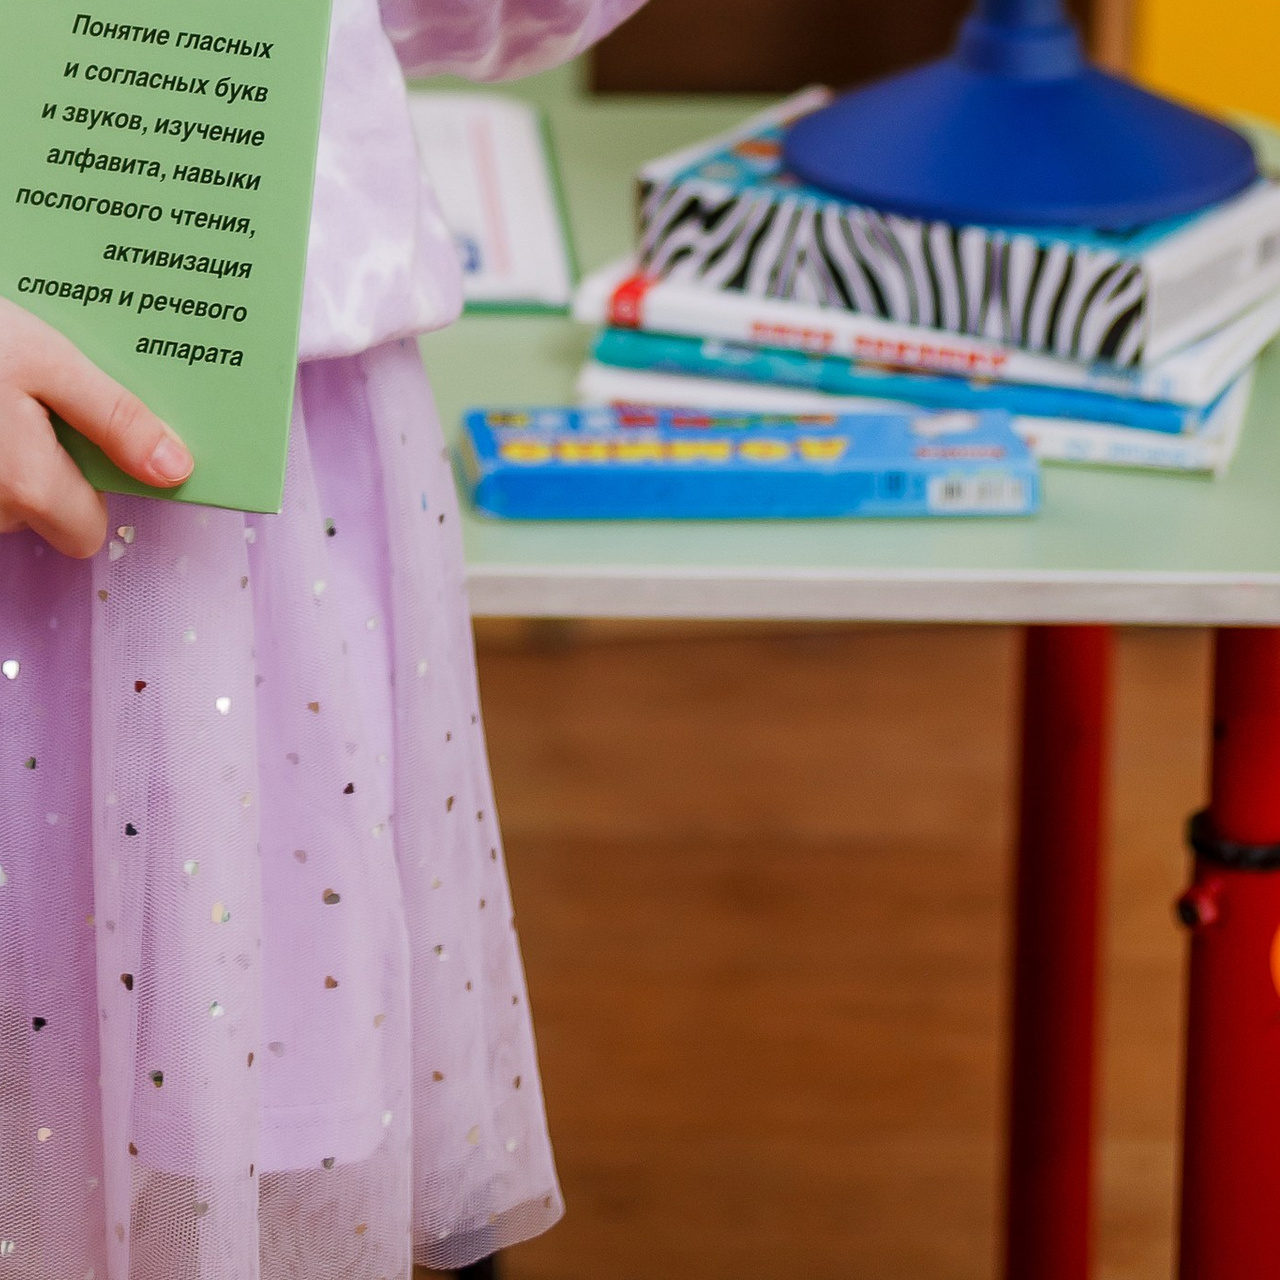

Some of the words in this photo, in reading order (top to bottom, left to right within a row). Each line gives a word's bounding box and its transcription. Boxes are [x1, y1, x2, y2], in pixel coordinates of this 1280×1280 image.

[72, 13, 170, 46] Понятие
[175, 30, 274, 59] гласных
[63, 61, 80, 78] и
[84, 63, 210, 95] согласных
[214, 76, 269, 104] букв
[41, 102, 58, 120] и
[62, 104, 148, 136] звуков,
[153, 116, 265, 147] изучение
[46, 147, 166, 183] алфавита,
[172, 163, 262, 191] навыки
[15, 187, 163, 222] послогового
[170, 207, 256, 239] чтения,
[103, 243, 253, 279] активизация
[17, 276, 114, 306] словаря
[118, 289, 135, 307] и
[136, 292, 248, 323] речевого
[135, 336, 244, 367] аппарата
